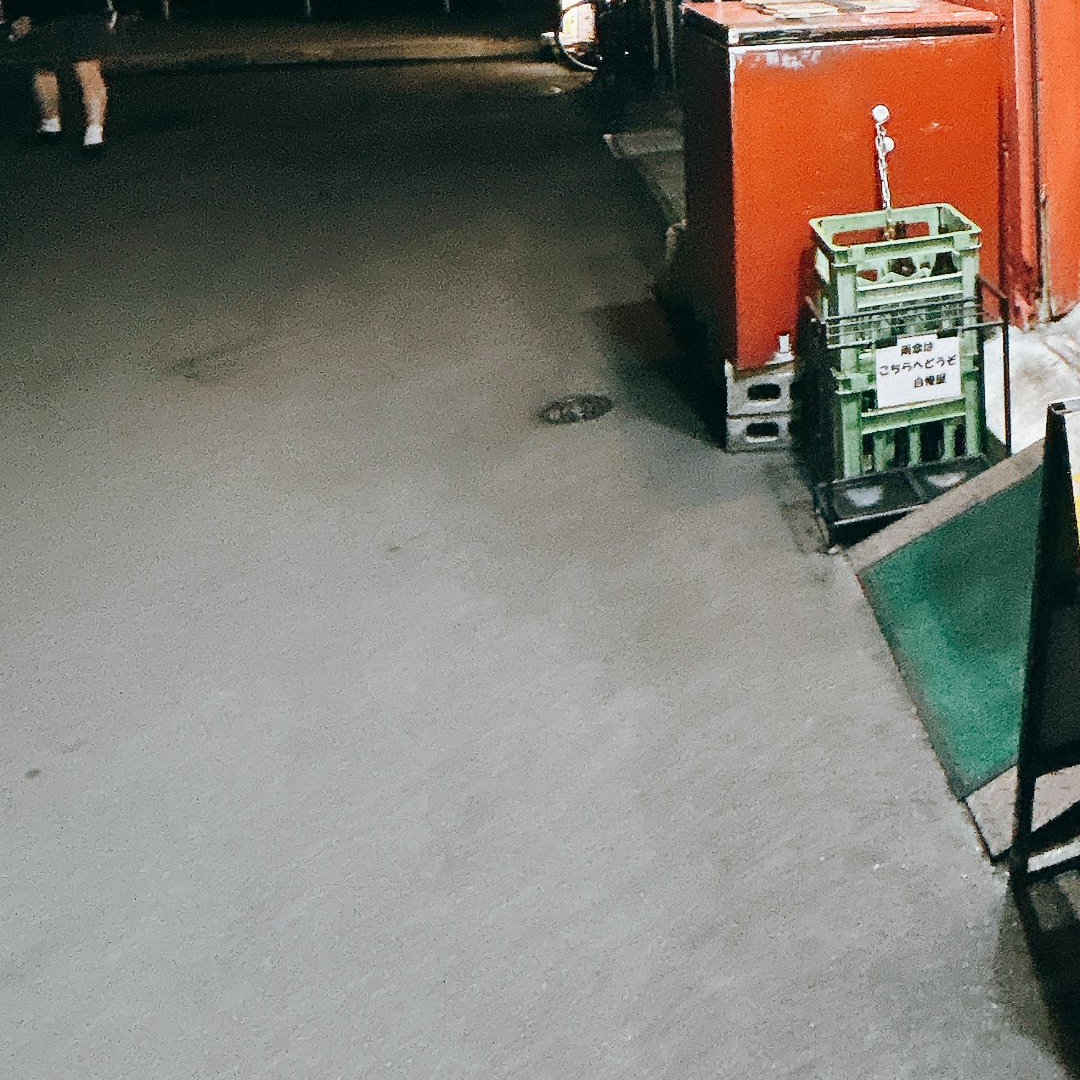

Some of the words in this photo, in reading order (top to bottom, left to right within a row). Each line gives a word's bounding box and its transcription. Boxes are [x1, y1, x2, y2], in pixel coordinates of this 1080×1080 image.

[878, 354, 957, 376] こちらへどうぞ
[914, 372, 947, 388] 自慢屋
